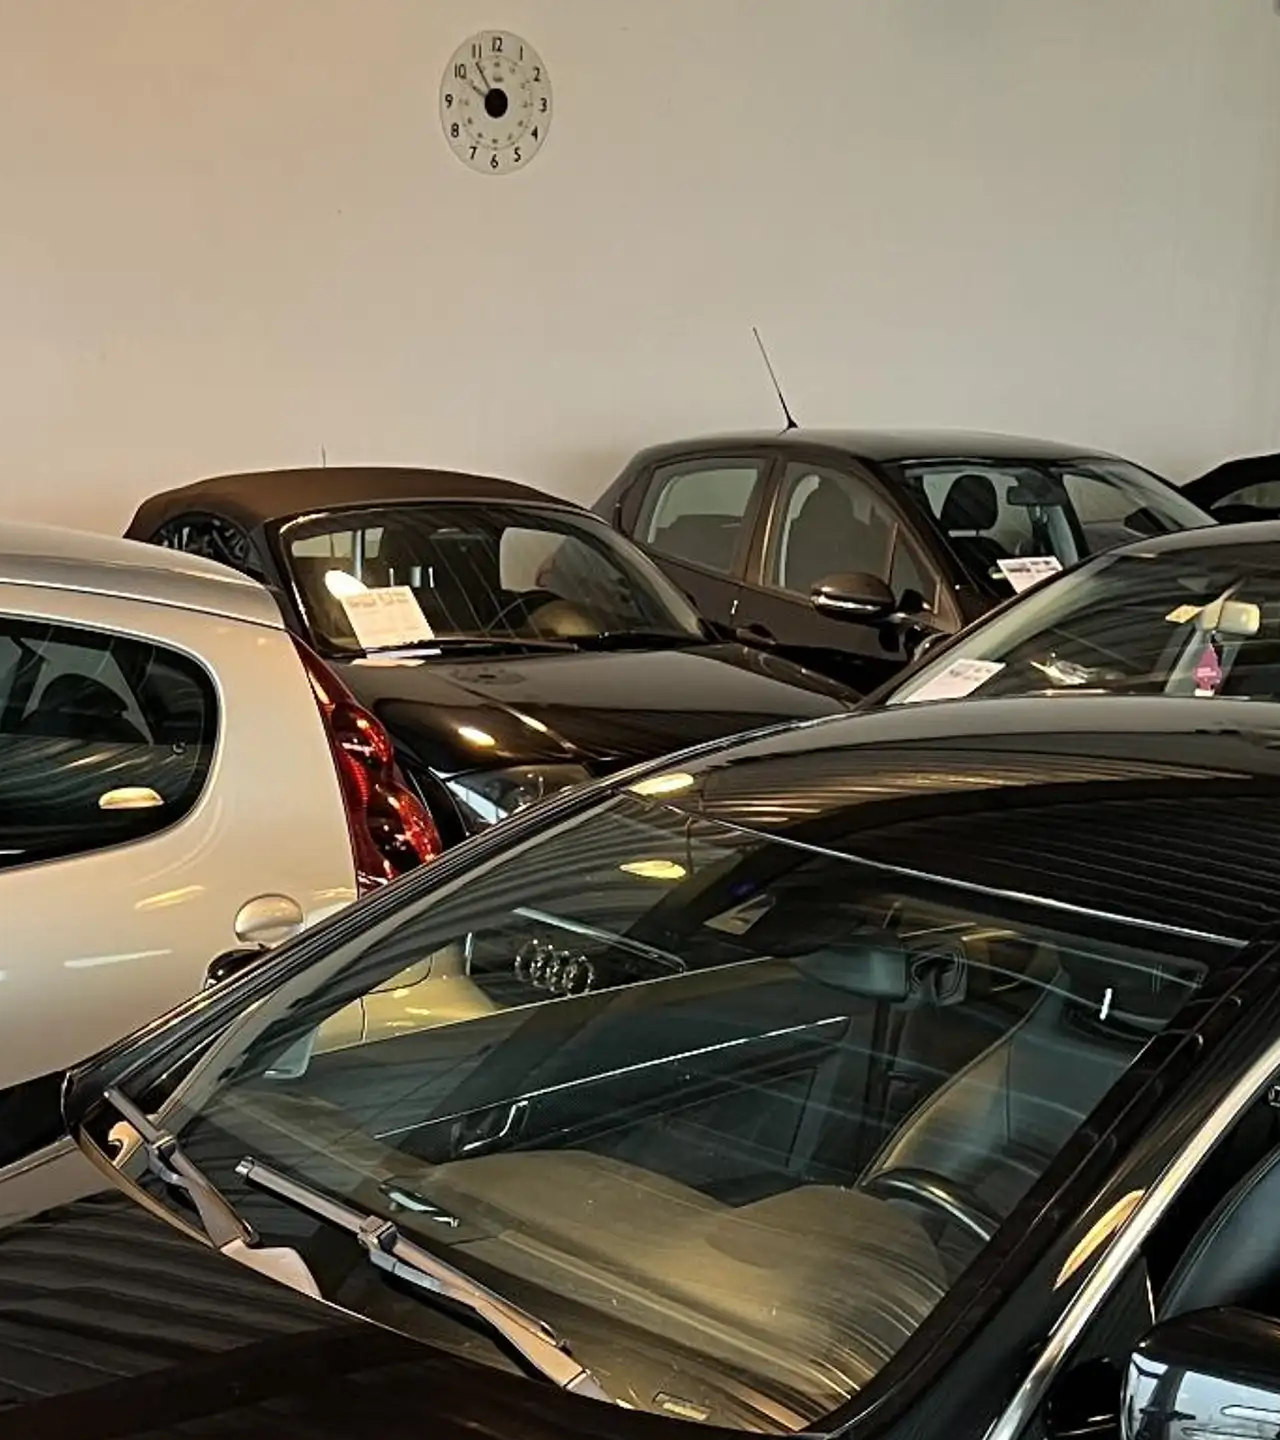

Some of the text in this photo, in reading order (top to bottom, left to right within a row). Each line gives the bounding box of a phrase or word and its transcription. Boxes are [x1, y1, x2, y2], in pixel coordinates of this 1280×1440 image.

[471, 43, 482, 59] 11
[491, 36, 503, 53] 12
[518, 44, 524, 61] 1
[454, 63, 467, 80] 10
[532, 66, 541, 82] 2
[444, 93, 454, 109] 9
[538, 97, 548, 113] 3
[450, 122, 460, 138] 8
[530, 125, 539, 142] 4
[469, 146, 477, 160] 7
[514, 146, 522, 162] 5
[490, 154, 499, 169] 6
